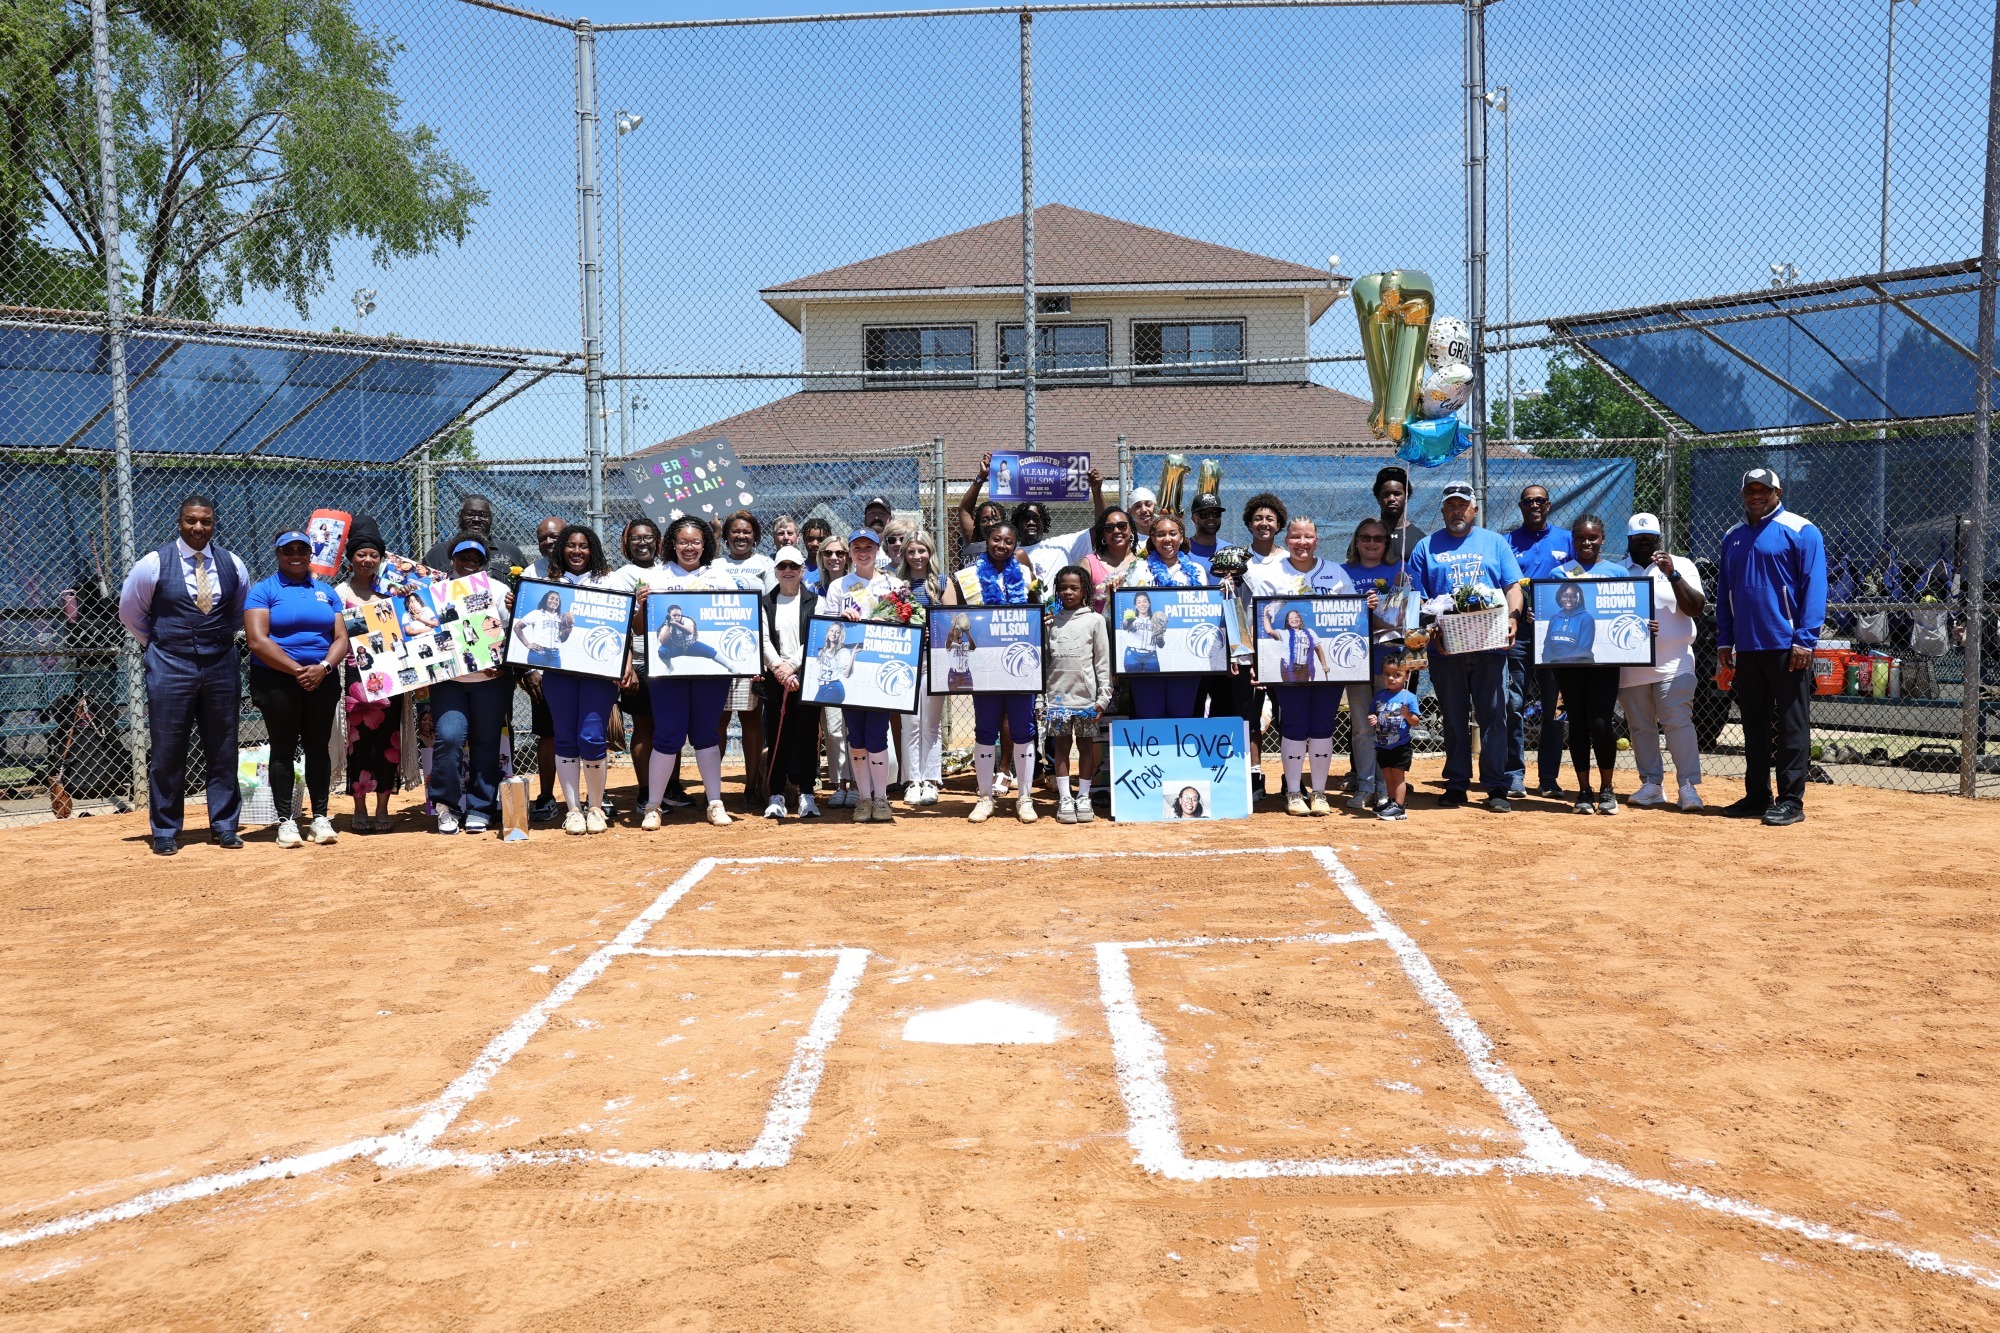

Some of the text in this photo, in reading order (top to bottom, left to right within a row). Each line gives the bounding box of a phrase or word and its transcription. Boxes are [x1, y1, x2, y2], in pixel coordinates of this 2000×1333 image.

[651, 456, 690, 476] HERE
[1020, 456, 1060, 466] CONGRATS!
[1068, 456, 1089, 474] 20
[663, 470, 694, 488] FOR
[1067, 476, 1089, 491] 26
[664, 486, 691, 502] LAI
[1448, 570, 1485, 579] TAMARAH
[430, 571, 490, 603] VAN
[1596, 582, 1635, 595] YADIRA
[574, 590, 626, 608] VANGILEES
[712, 594, 740, 607] LAILA
[1177, 591, 1209, 604] TREJA
[1596, 596, 1636, 609] BROWN
[570, 602, 626, 622] CHAMBERS
[1165, 604, 1221, 617] PATTERSON
[1311, 600, 1362, 613] TAMARAH
[700, 608, 752, 621] HOLLOWAY
[992, 610, 1027, 622] A'LEAH
[1316, 613, 1357, 627] LOWERY
[865, 625, 911, 642] ISABELLA
[990, 623, 1029, 636] WILSON
[863, 638, 911, 655] RUMBOLD
[1124, 724, 1234, 759] We love
[1114, 764, 1165, 800] Treja
